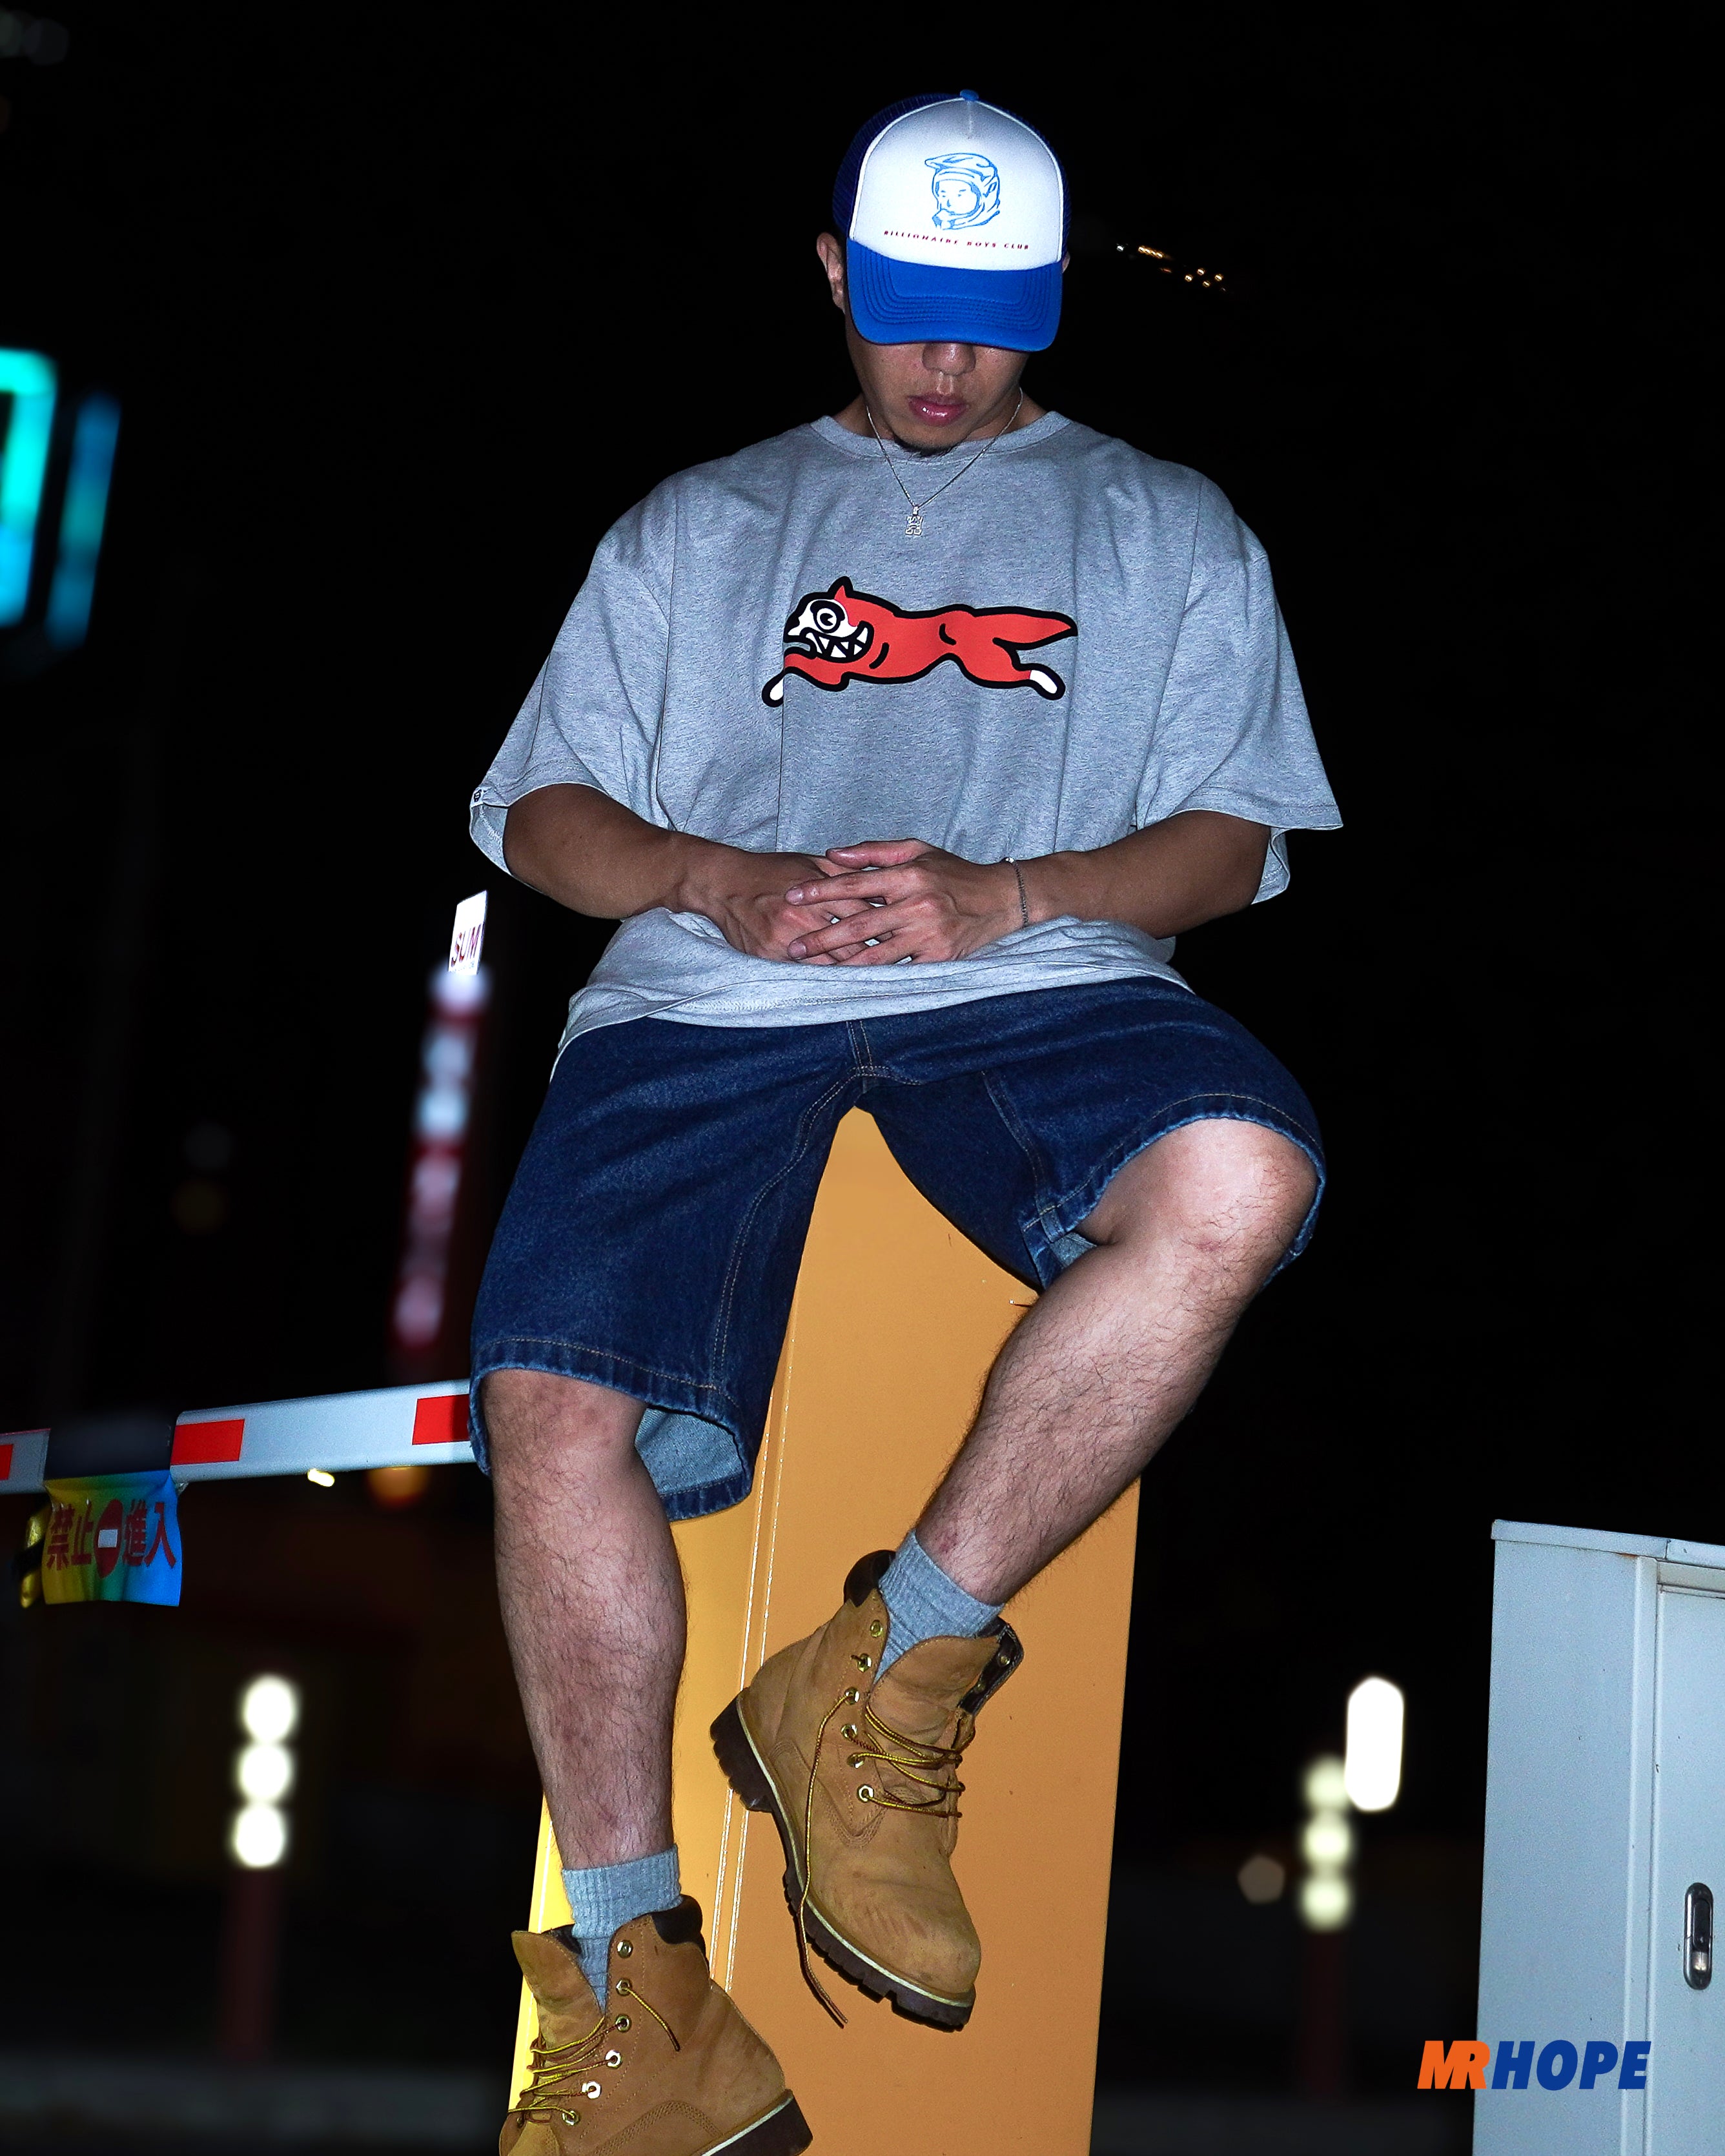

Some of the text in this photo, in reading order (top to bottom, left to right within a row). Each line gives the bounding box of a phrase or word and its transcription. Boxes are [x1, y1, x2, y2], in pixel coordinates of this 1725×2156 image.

[884, 230, 959, 245] BILLIONAIRE
[46, 1499, 176, 1571] 禁止 進入
